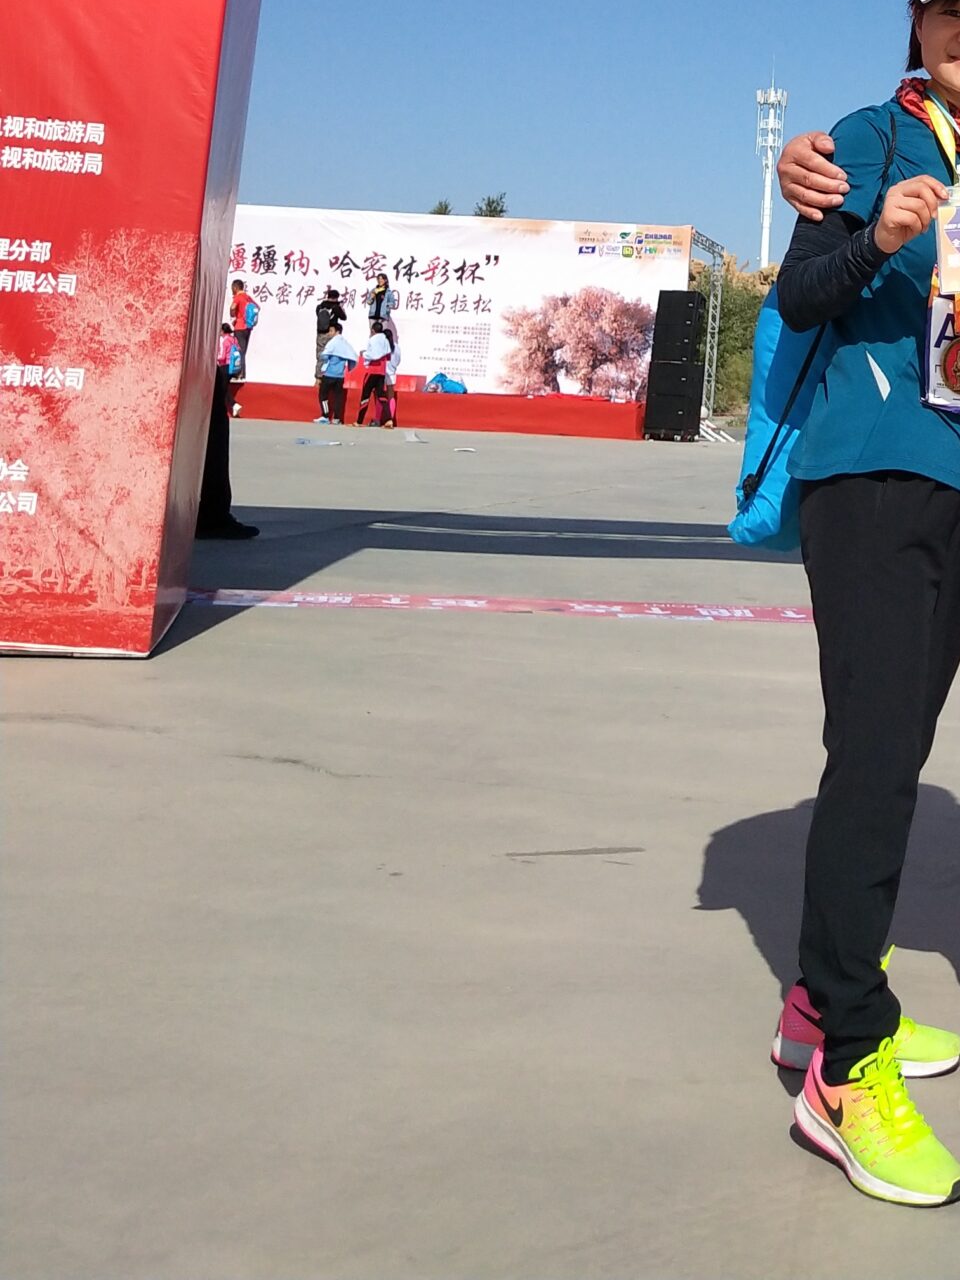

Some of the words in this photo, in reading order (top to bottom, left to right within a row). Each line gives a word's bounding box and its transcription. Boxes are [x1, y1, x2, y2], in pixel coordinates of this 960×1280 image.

[0, 115, 105, 145] 视和旅游局
[0, 146, 103, 176] 视和旅游局
[0, 363, 85, 391] 有限公司
